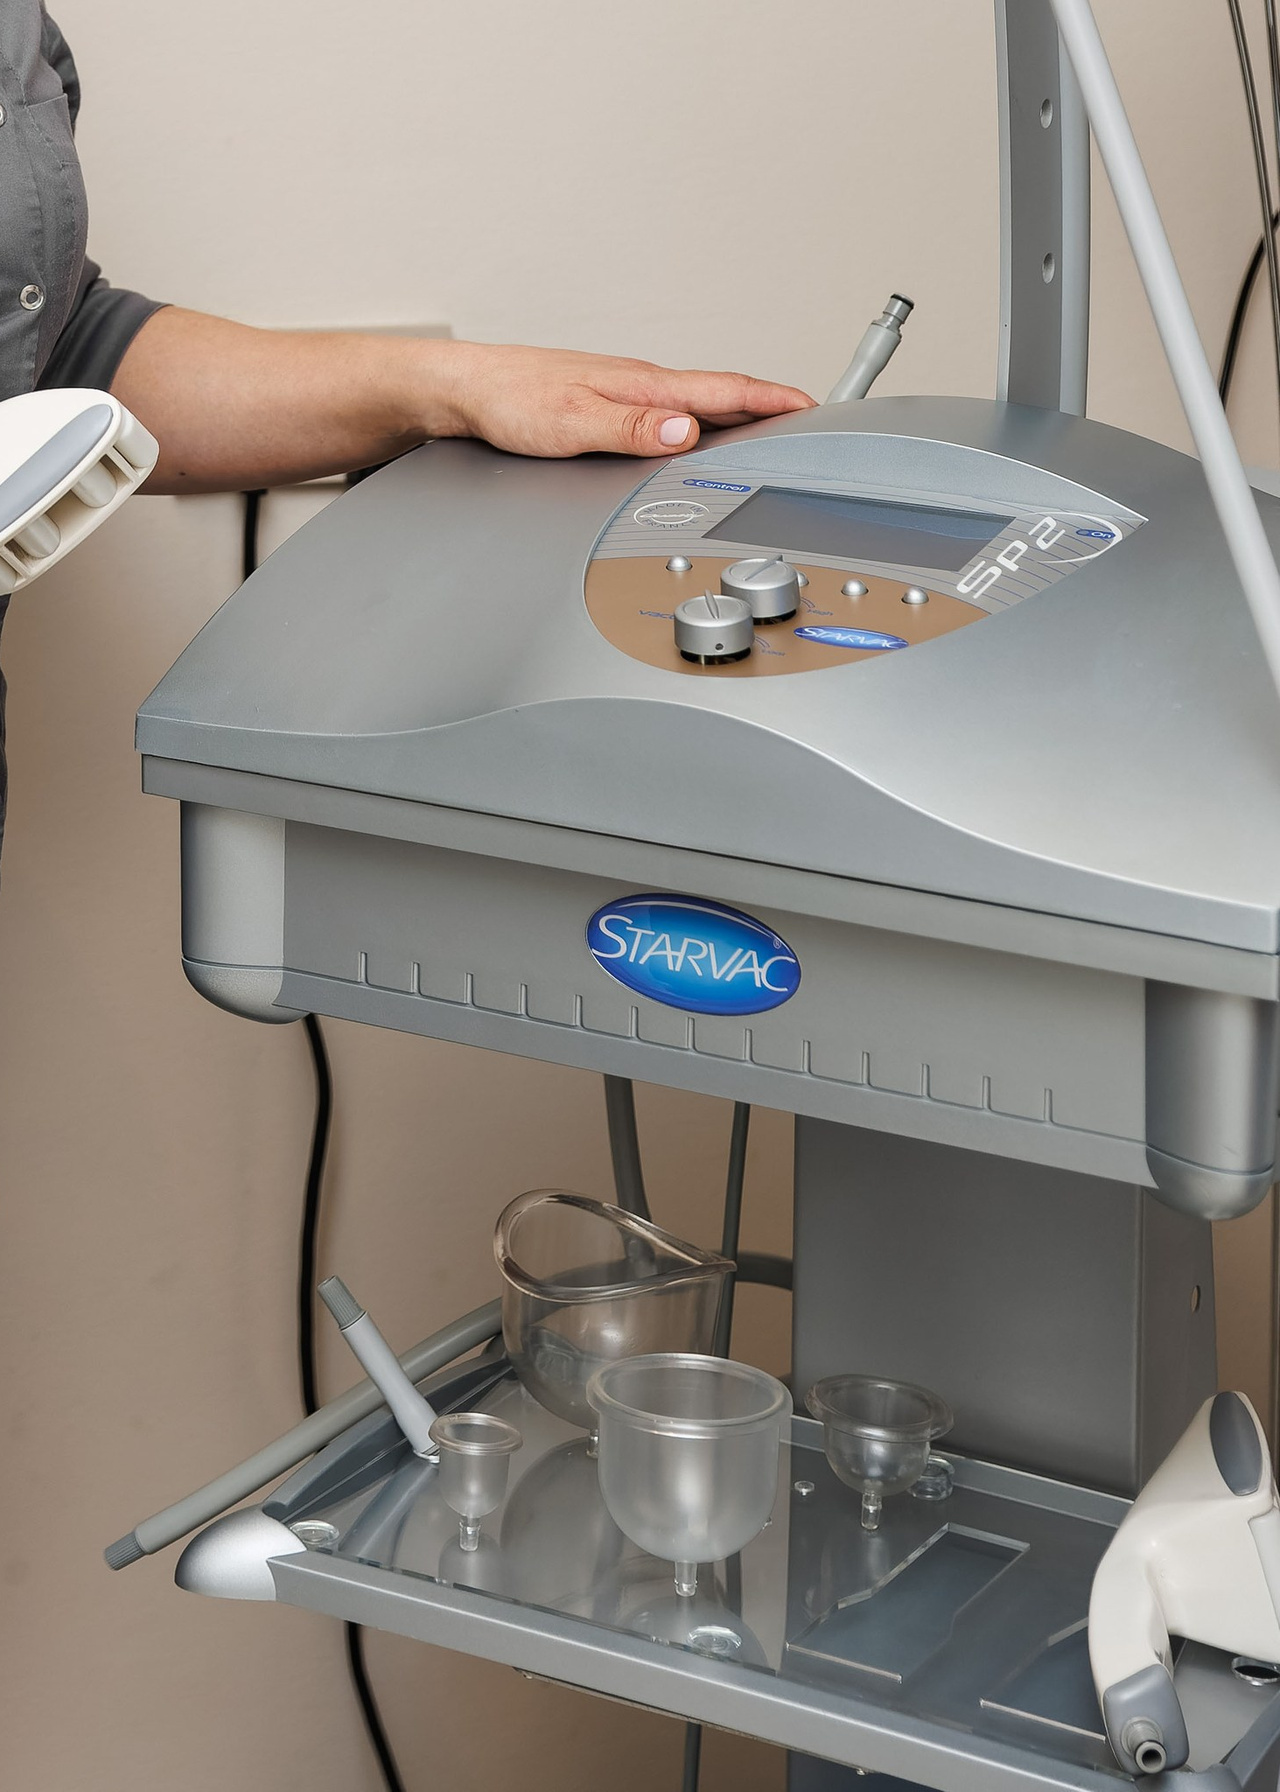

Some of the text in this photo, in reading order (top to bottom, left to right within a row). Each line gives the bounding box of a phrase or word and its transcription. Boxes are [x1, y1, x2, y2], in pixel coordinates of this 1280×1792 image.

[696, 480, 744, 492] Control
[1091, 531, 1112, 539] On
[795, 627, 905, 649] STARVAC
[591, 914, 797, 992] STARVAC
